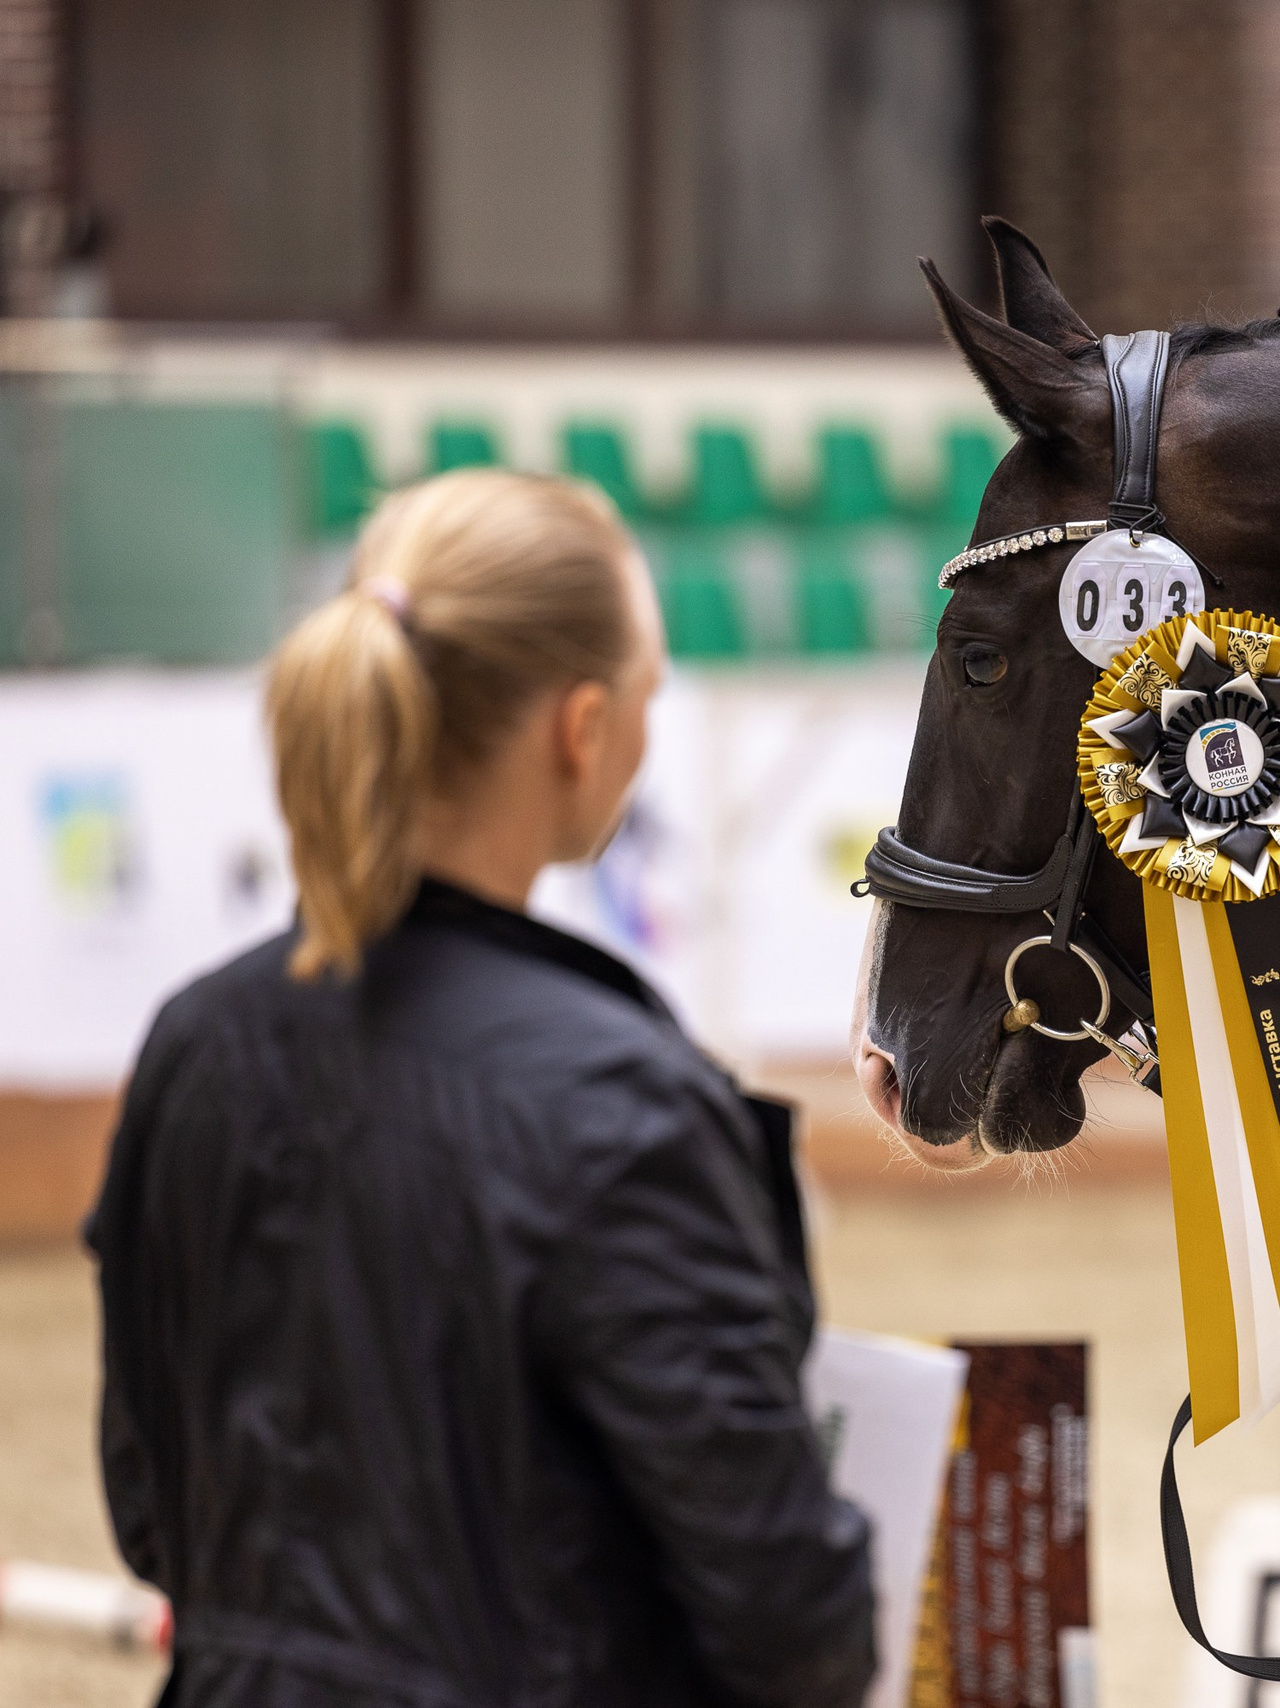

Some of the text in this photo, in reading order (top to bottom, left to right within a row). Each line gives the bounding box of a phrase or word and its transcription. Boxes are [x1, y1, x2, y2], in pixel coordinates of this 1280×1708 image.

[1076, 578, 1188, 632] 033
[1209, 766, 1247, 780] КОННАЯ
[1210, 775, 1249, 789] РОССИЯ
